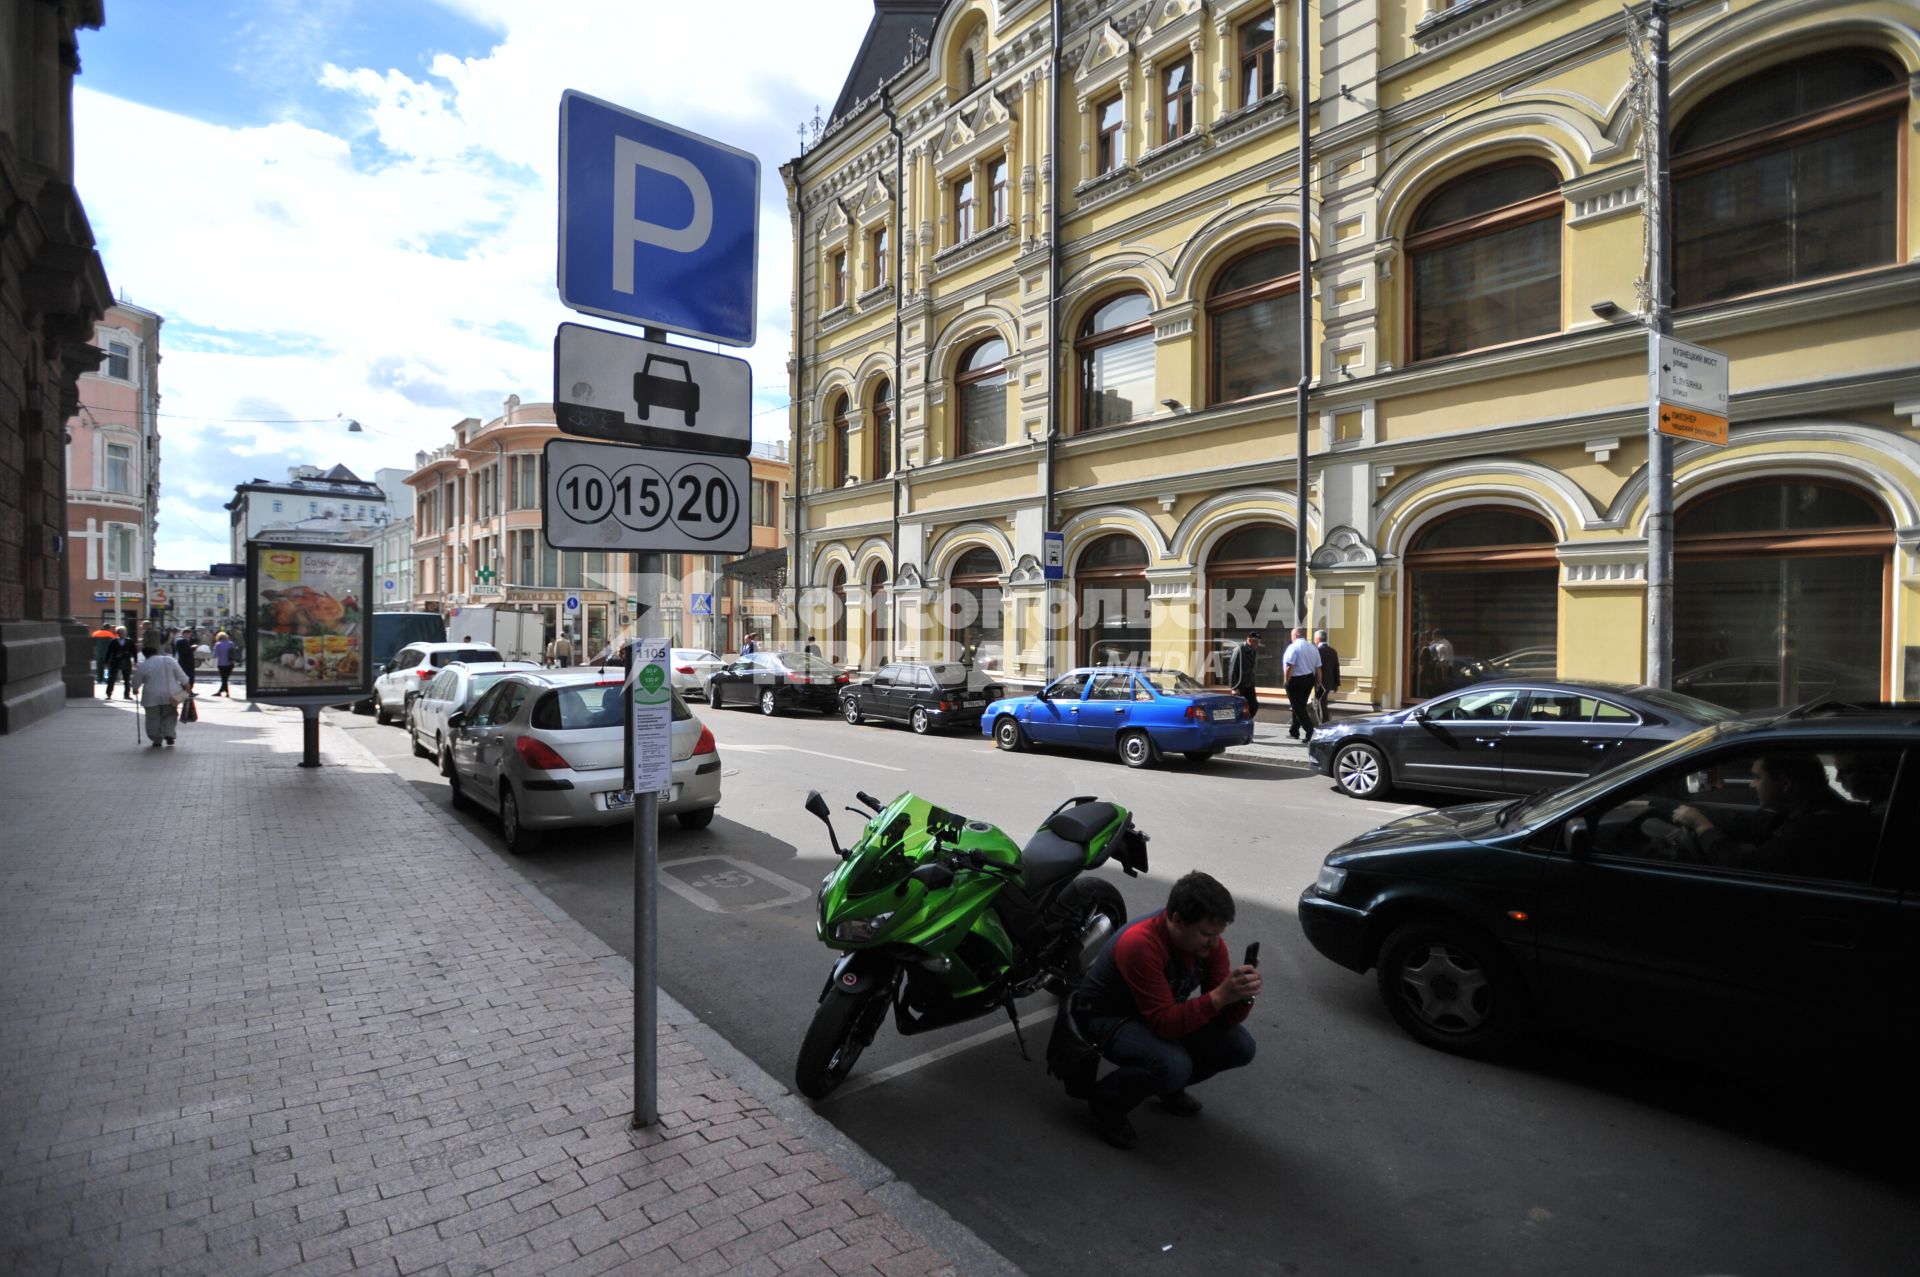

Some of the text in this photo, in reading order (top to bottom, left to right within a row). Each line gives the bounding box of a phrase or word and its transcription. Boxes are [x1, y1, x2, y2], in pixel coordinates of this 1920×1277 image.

[613, 135, 713, 295] P
[1672, 346, 1718, 367] КУЗНЕЦКИЙ МОСТ
[566, 475, 728, 523] 10 15 20
[474, 585, 498, 595] АПТЕКА
[635, 647, 666, 659] 1105
